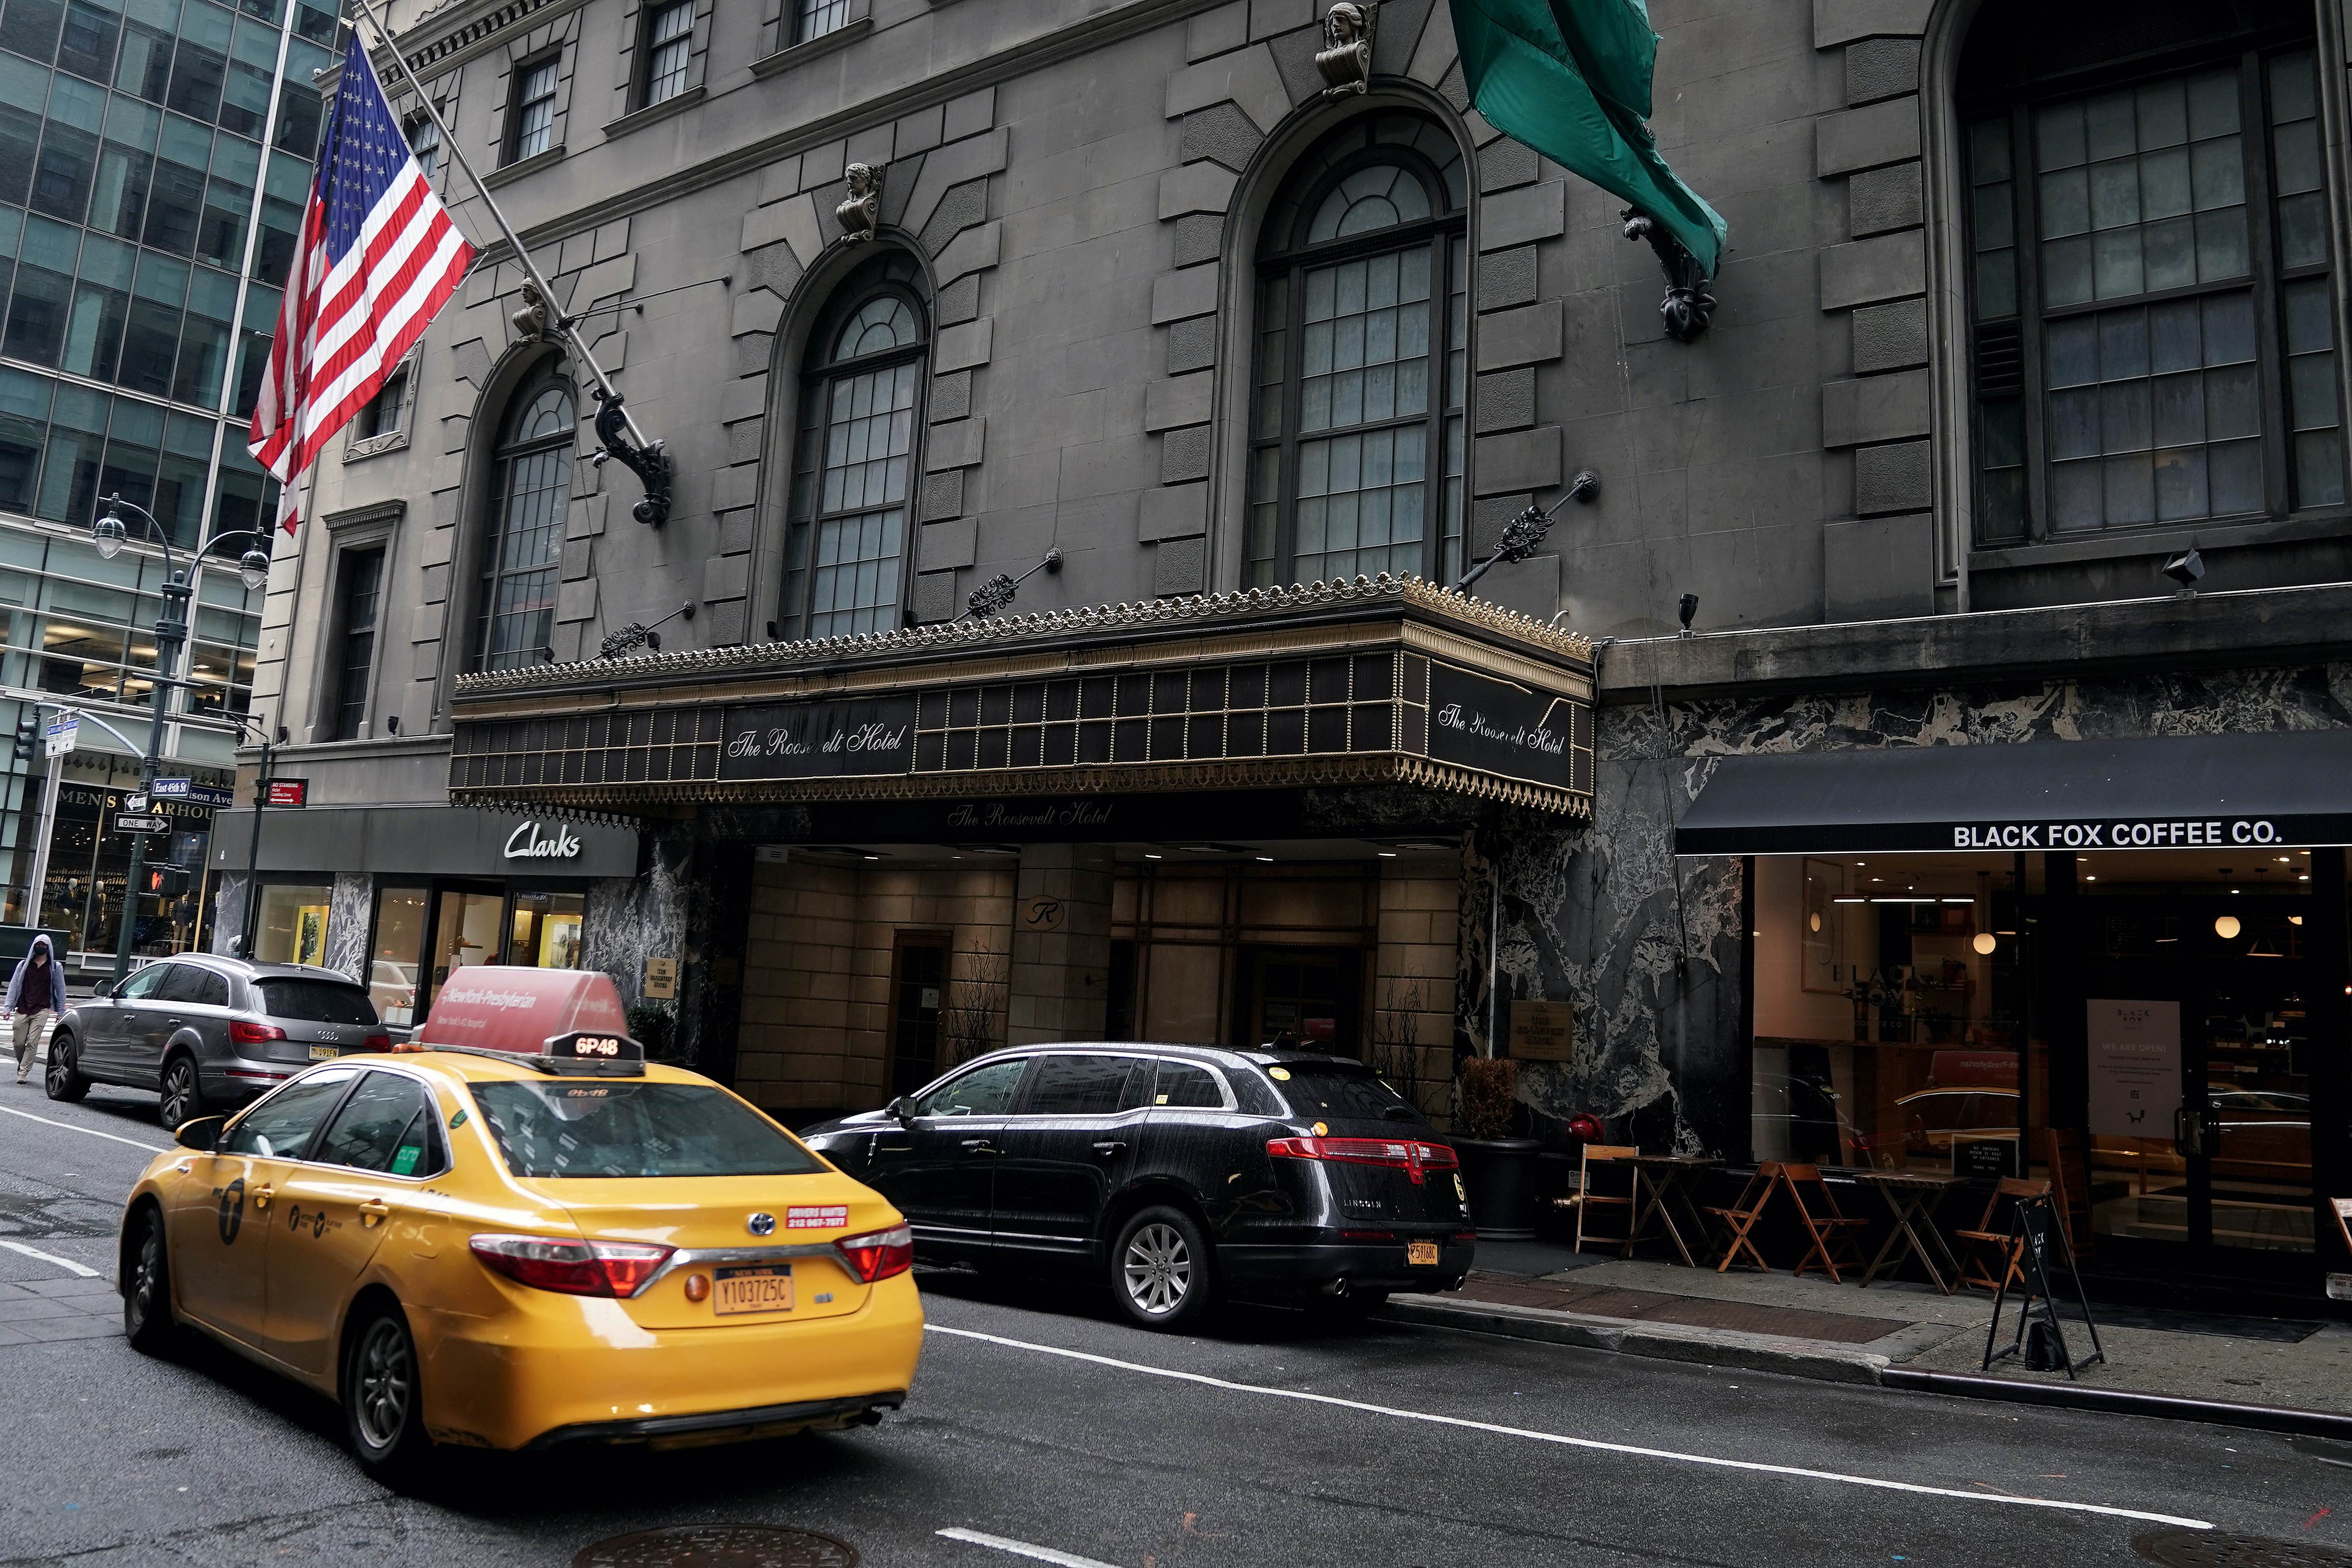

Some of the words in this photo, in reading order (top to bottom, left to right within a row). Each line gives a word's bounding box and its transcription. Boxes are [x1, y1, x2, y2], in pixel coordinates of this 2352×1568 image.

[1438, 703, 1466, 730] The
[1527, 727, 1564, 750] Hotel
[728, 730, 761, 758] The
[846, 723, 907, 752] Hotel
[154, 782, 167, 792] East
[167, 783, 179, 792] 45th
[179, 782, 187, 792] St
[189, 790, 210, 802] ison
[212, 793, 232, 804] Ave
[947, 803, 980, 827] The
[985, 802, 1056, 827] Roosevelt
[1059, 800, 1113, 826] Hotel
[123, 819, 139, 827] ONE
[504, 819, 582, 858] Clarks
[1954, 825, 2040, 847] BLACK
[2048, 824, 2103, 846] FOX
[2111, 822, 2222, 845] COFFEE
[2232, 820, 2282, 843] CO.
[575, 1037, 619, 1056] 6P48
[2139, 1044, 2167, 1053] OPEN!
[1343, 1198, 1381, 1208] LINCOLN
[788, 1218, 805, 1227] 212
[2034, 1232, 2045, 1246] ACK
[722, 1277, 786, 1304] Y103725C
